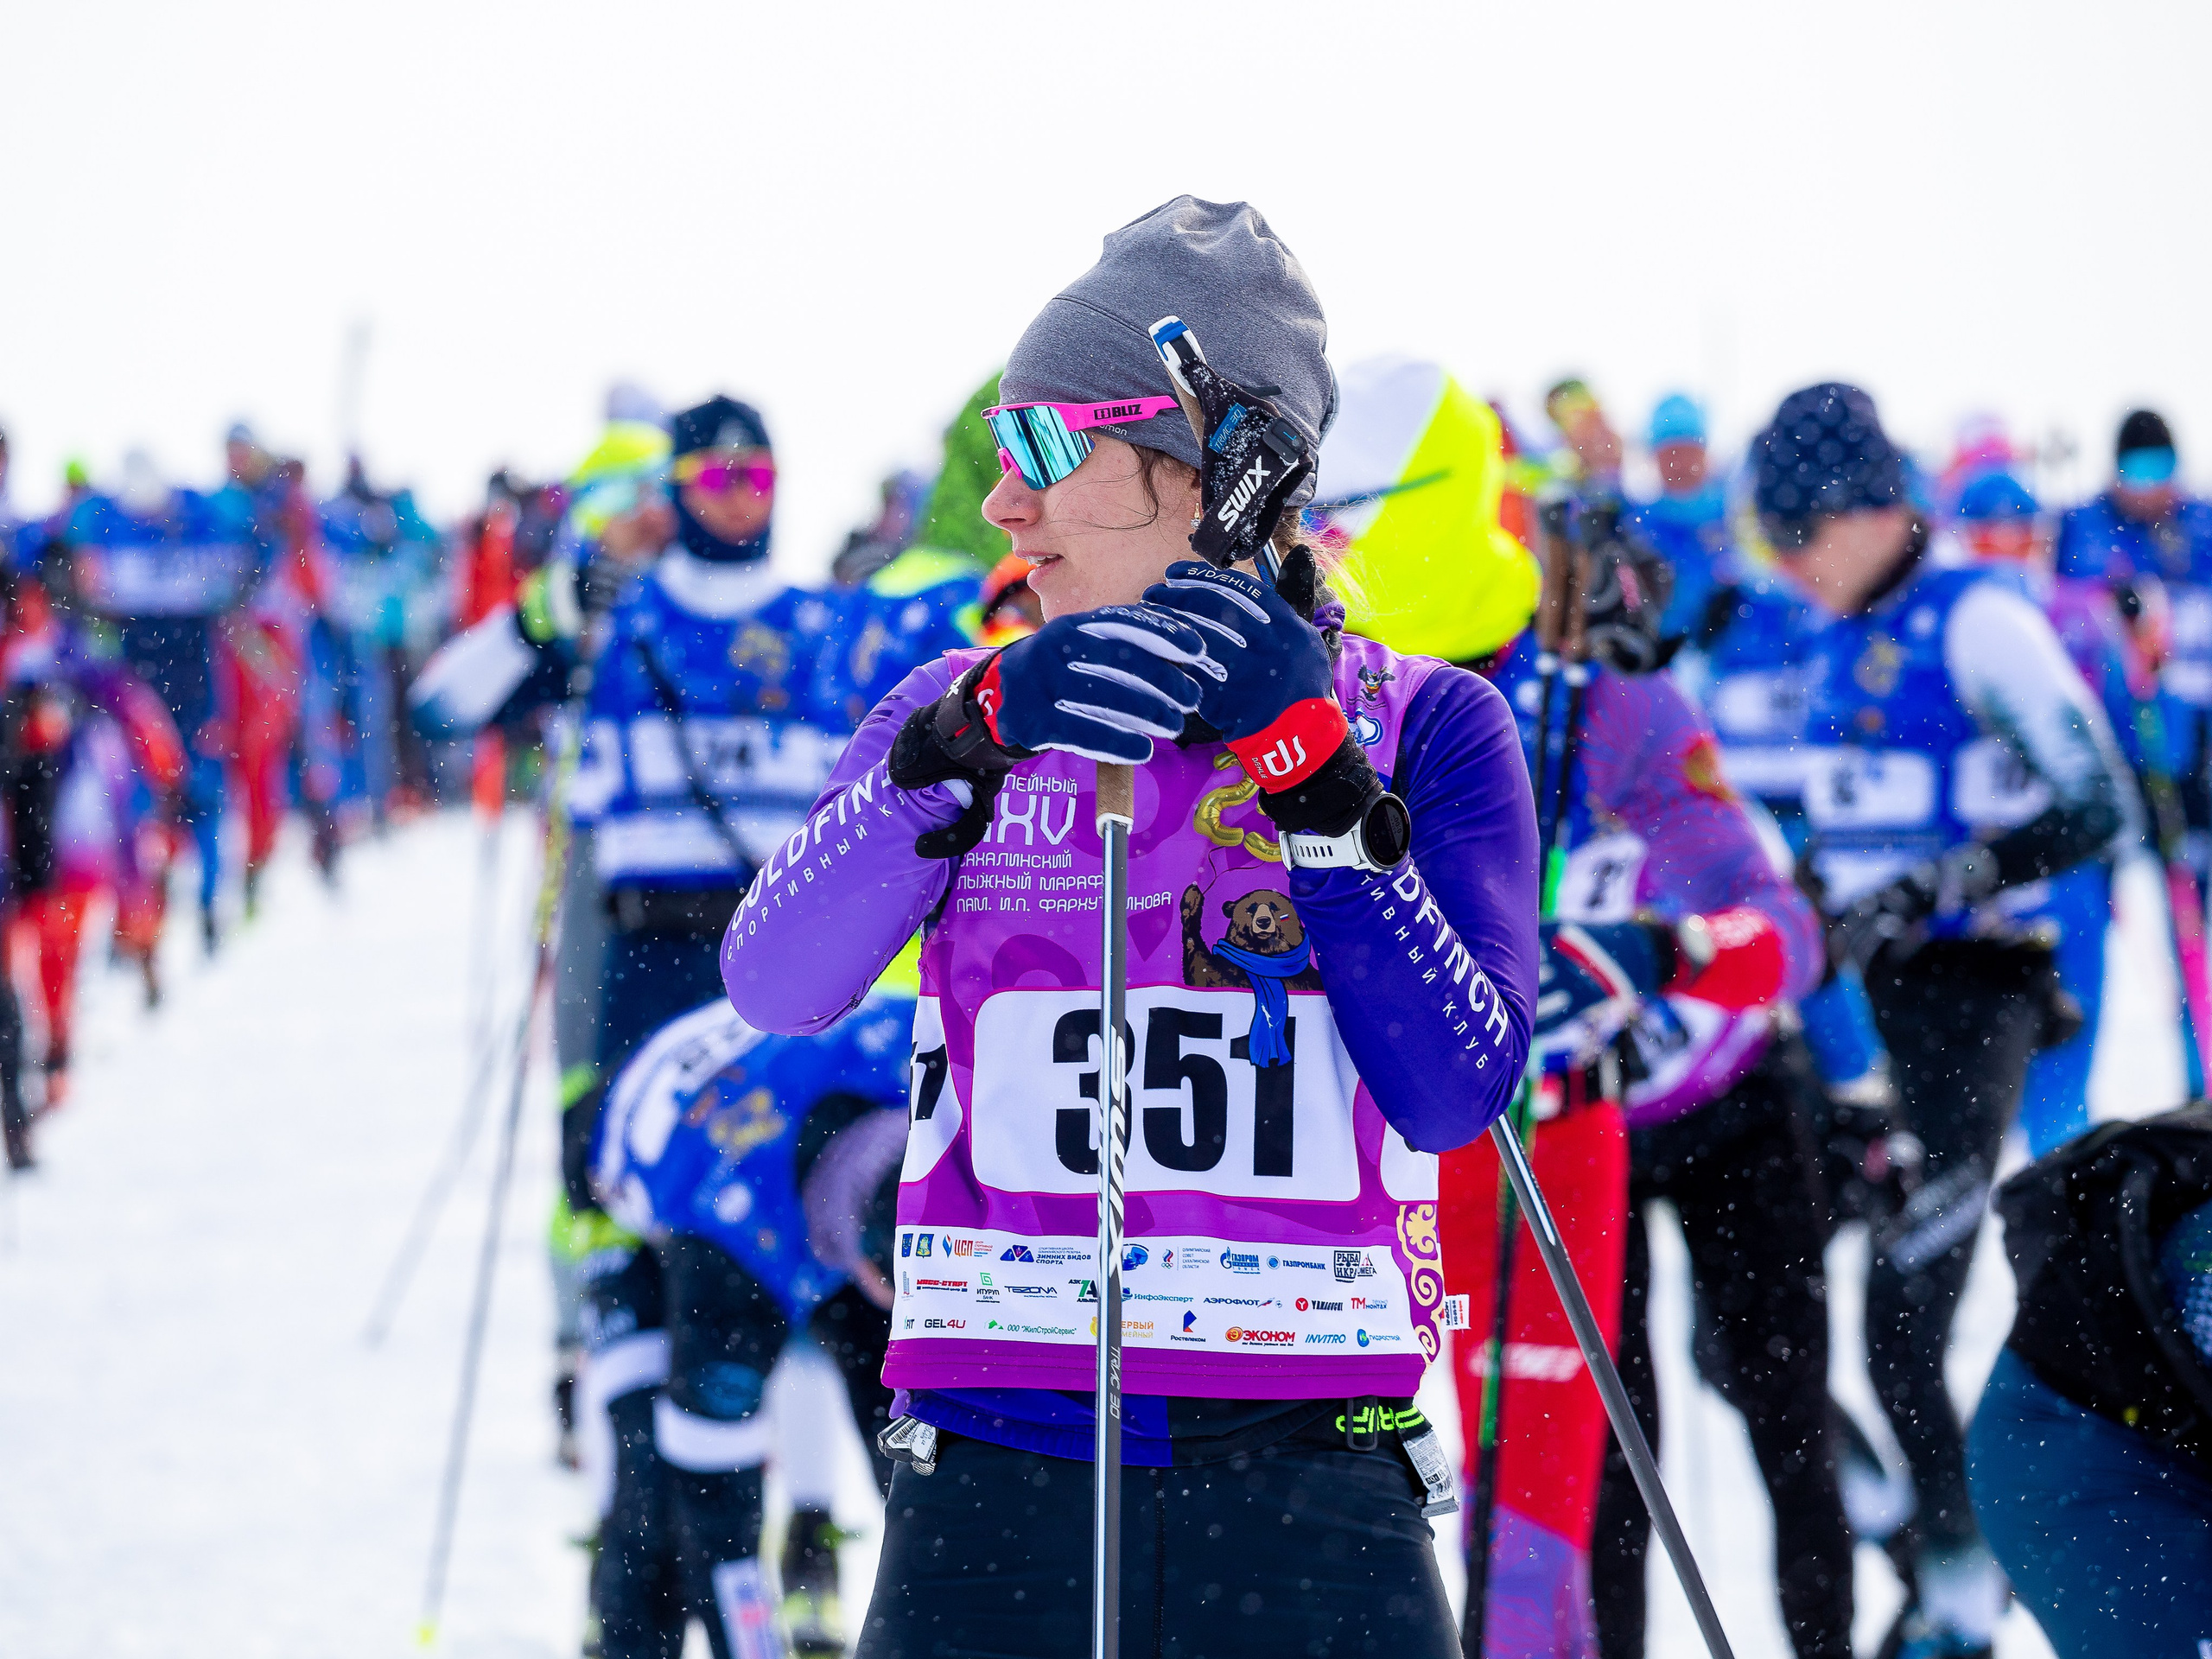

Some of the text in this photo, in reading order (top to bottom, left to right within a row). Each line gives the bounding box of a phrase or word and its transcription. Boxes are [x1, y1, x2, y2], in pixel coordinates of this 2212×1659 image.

[1112, 404, 1142, 417] BLIZ
[1214, 423, 1232, 450] TRIAC
[1217, 454, 1271, 533] SWIX
[1002, 773, 1077, 796] ЛЕЙНЫЙ
[983, 792, 1077, 845] XV
[732, 759, 893, 931] GOLDFIN
[727, 792, 906, 961] СПОРТИВНЫЙ КЛ
[957, 871, 1103, 891] ЛЫЖНЫЙ МАРАФ
[957, 896, 992, 912] ПАМ.
[1000, 896, 1031, 912] И.П.
[1384, 864, 1509, 1047] DFINCH
[1360, 874, 1489, 1070] ТИВНЫЙ КЛУБ
[1052, 1007, 1295, 1178] 351
[1107, 1024, 1126, 1296] SWIX
[954, 1239, 974, 1257] ЦСП
[1231, 1253, 1259, 1262] ГАЗПРОМ
[1282, 1260, 1326, 1270] ГАЗПРОМБАНК
[1337, 1253, 1359, 1262] РЫБА
[1134, 1294, 1194, 1303] ИнфоЭксперт
[1203, 1297, 1260, 1306] АЭРОФЛОТ
[924, 1319, 966, 1329] GEL4U
[1122, 1320, 1154, 1330] ЕРВЫЙ
[1243, 1330, 1296, 1343] ЭКОНОМ
[1305, 1333, 1346, 1344] INVITRO
